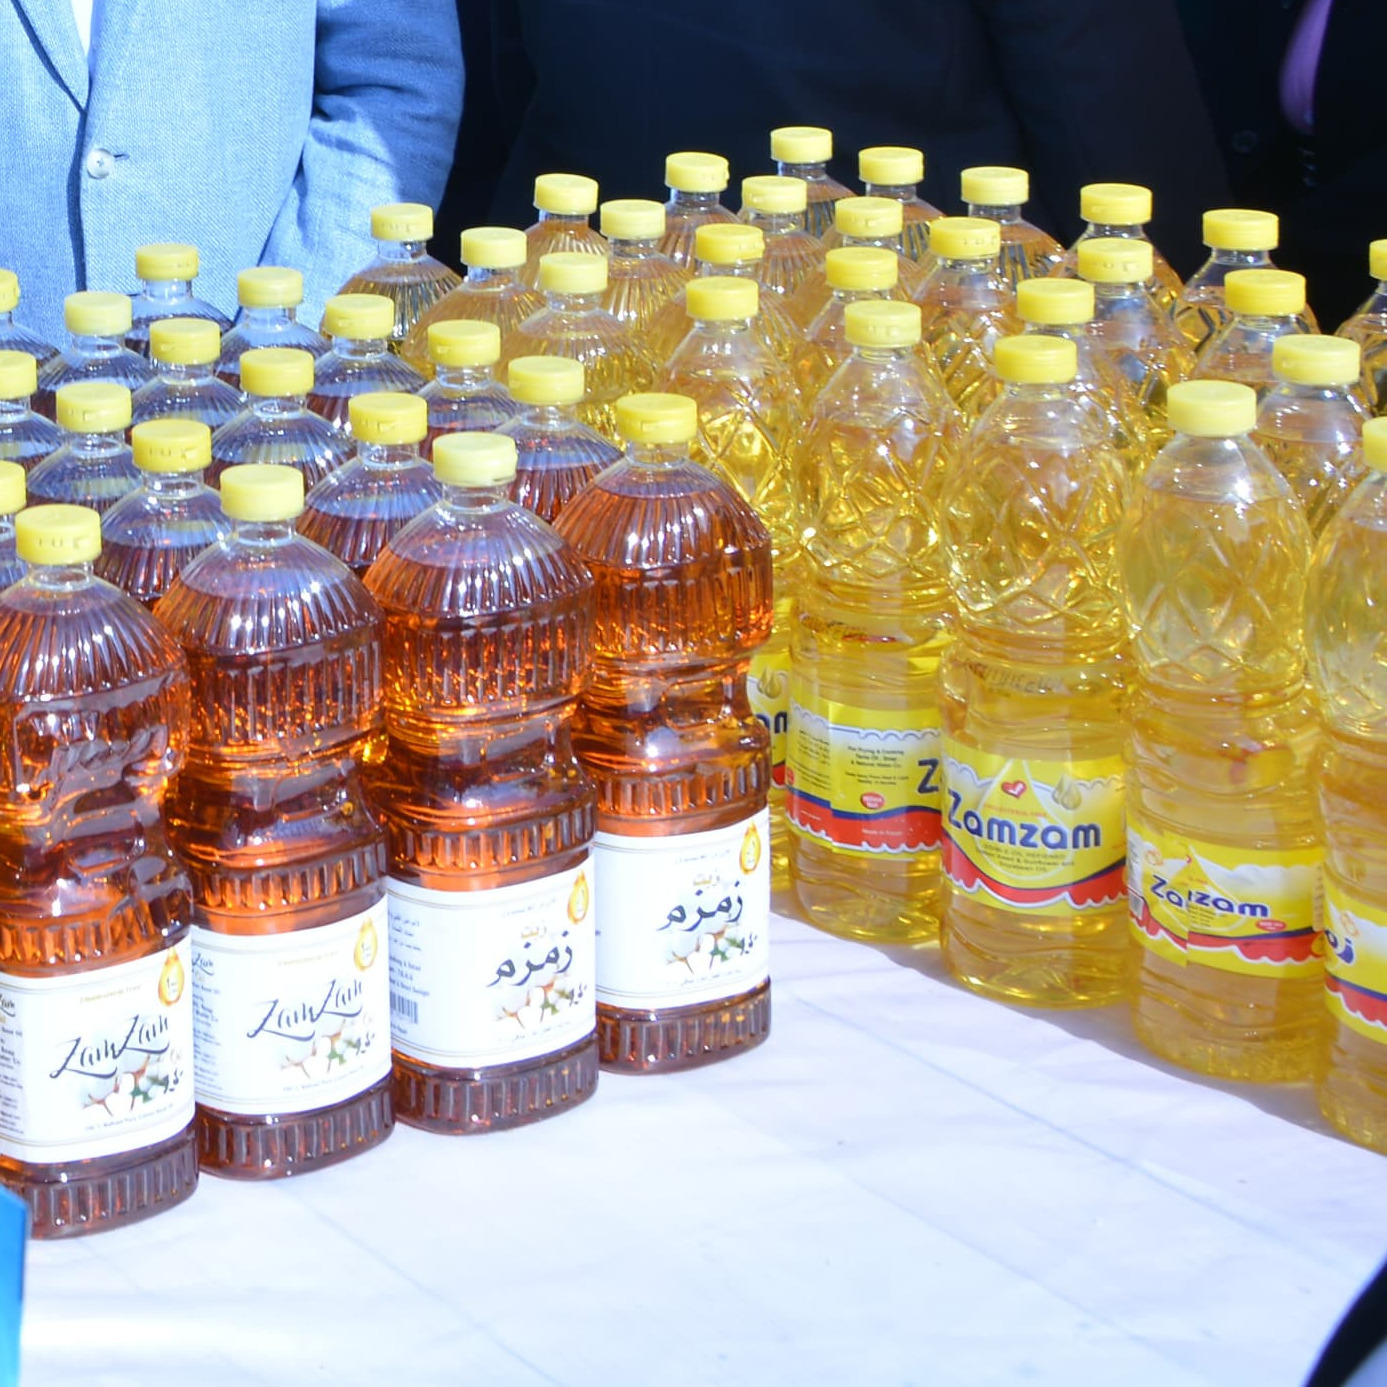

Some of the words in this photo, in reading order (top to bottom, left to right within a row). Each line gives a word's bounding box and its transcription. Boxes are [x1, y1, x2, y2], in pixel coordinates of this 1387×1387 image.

[947, 788, 1102, 850] Zamzam
[656, 880, 743, 932] زمزم
[485, 930, 574, 988] زمزم
